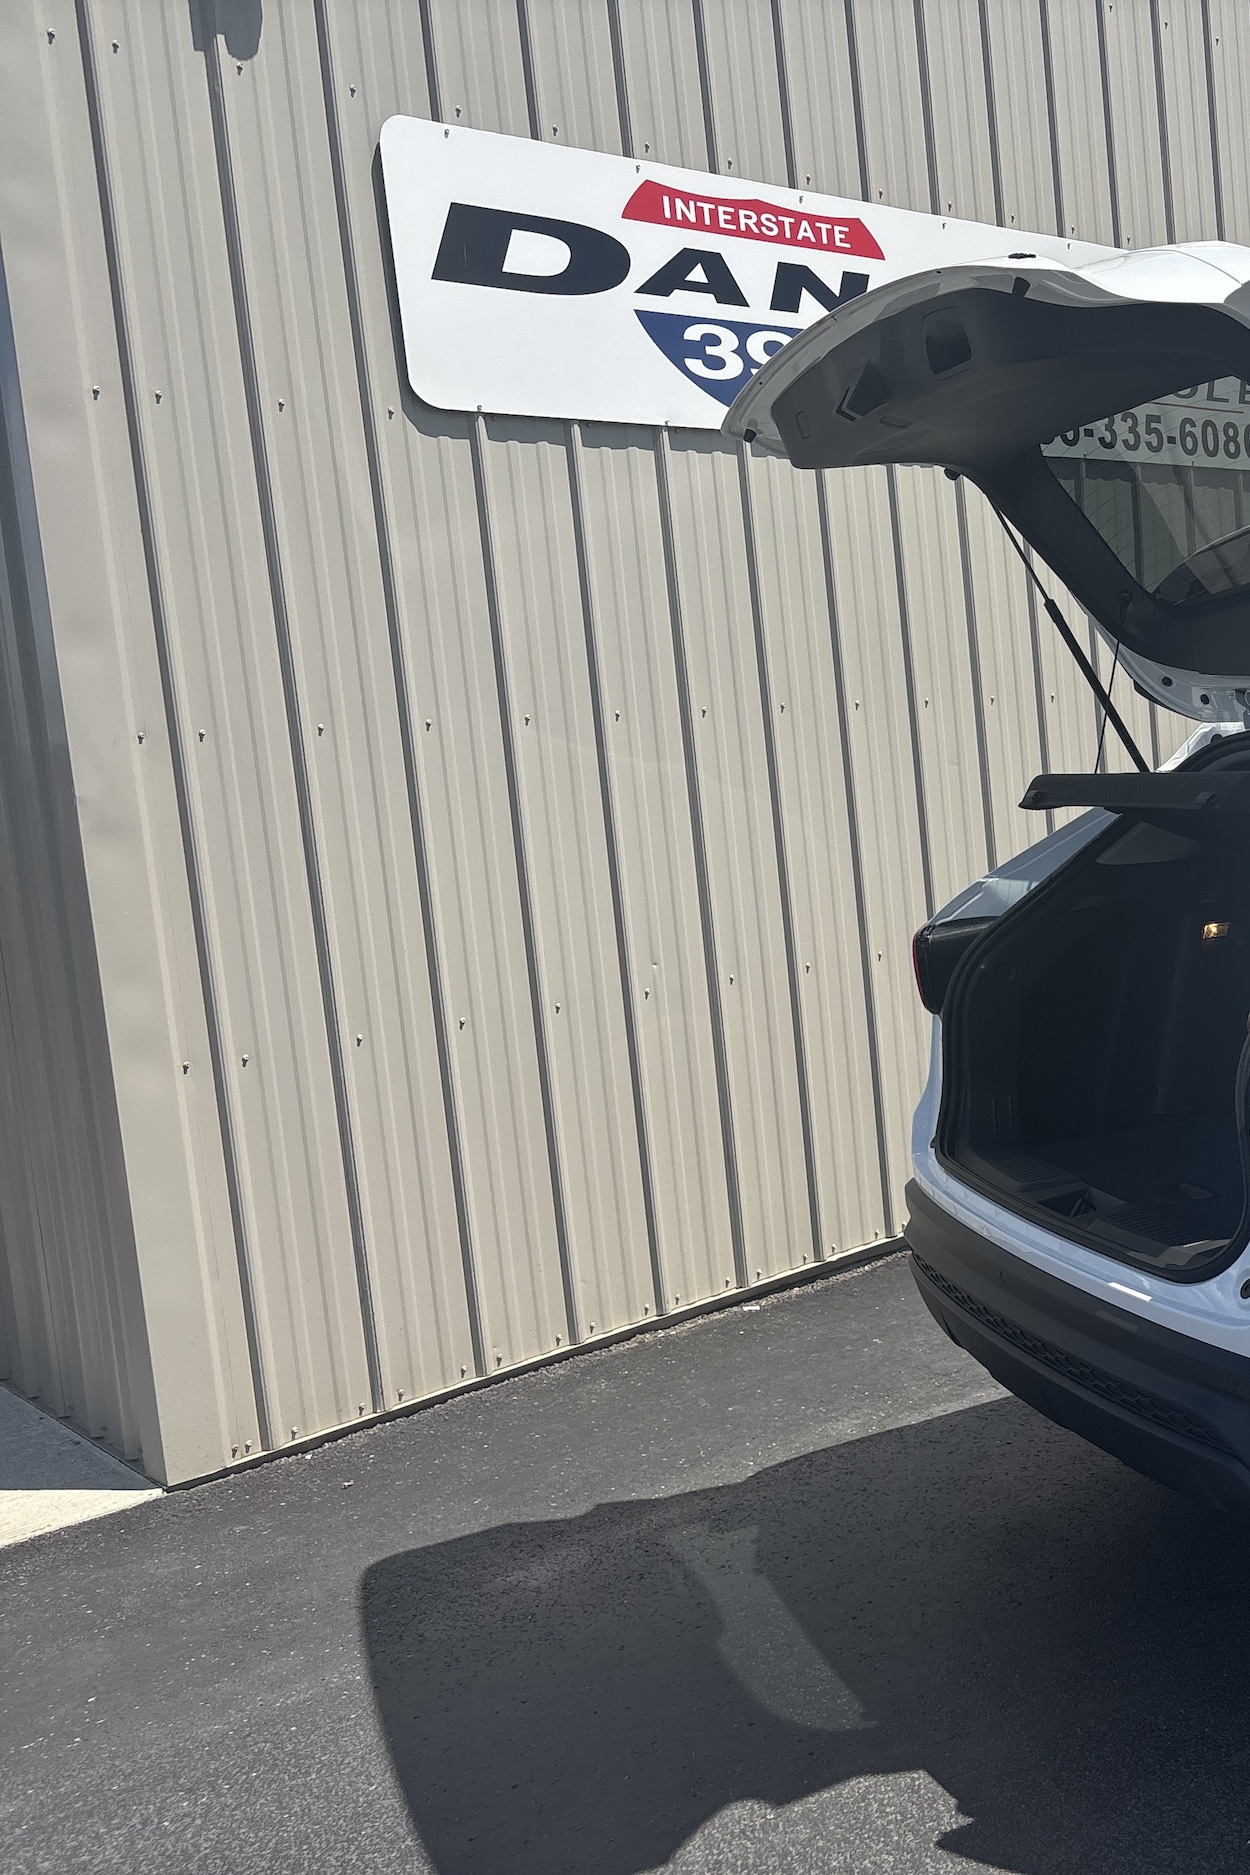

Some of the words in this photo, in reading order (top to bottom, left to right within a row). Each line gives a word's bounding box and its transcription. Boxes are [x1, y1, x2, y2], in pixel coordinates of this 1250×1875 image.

[662, 195, 852, 249] INTERSTATE
[431, 201, 870, 314] DAN
[683, 323, 793, 380] 39
